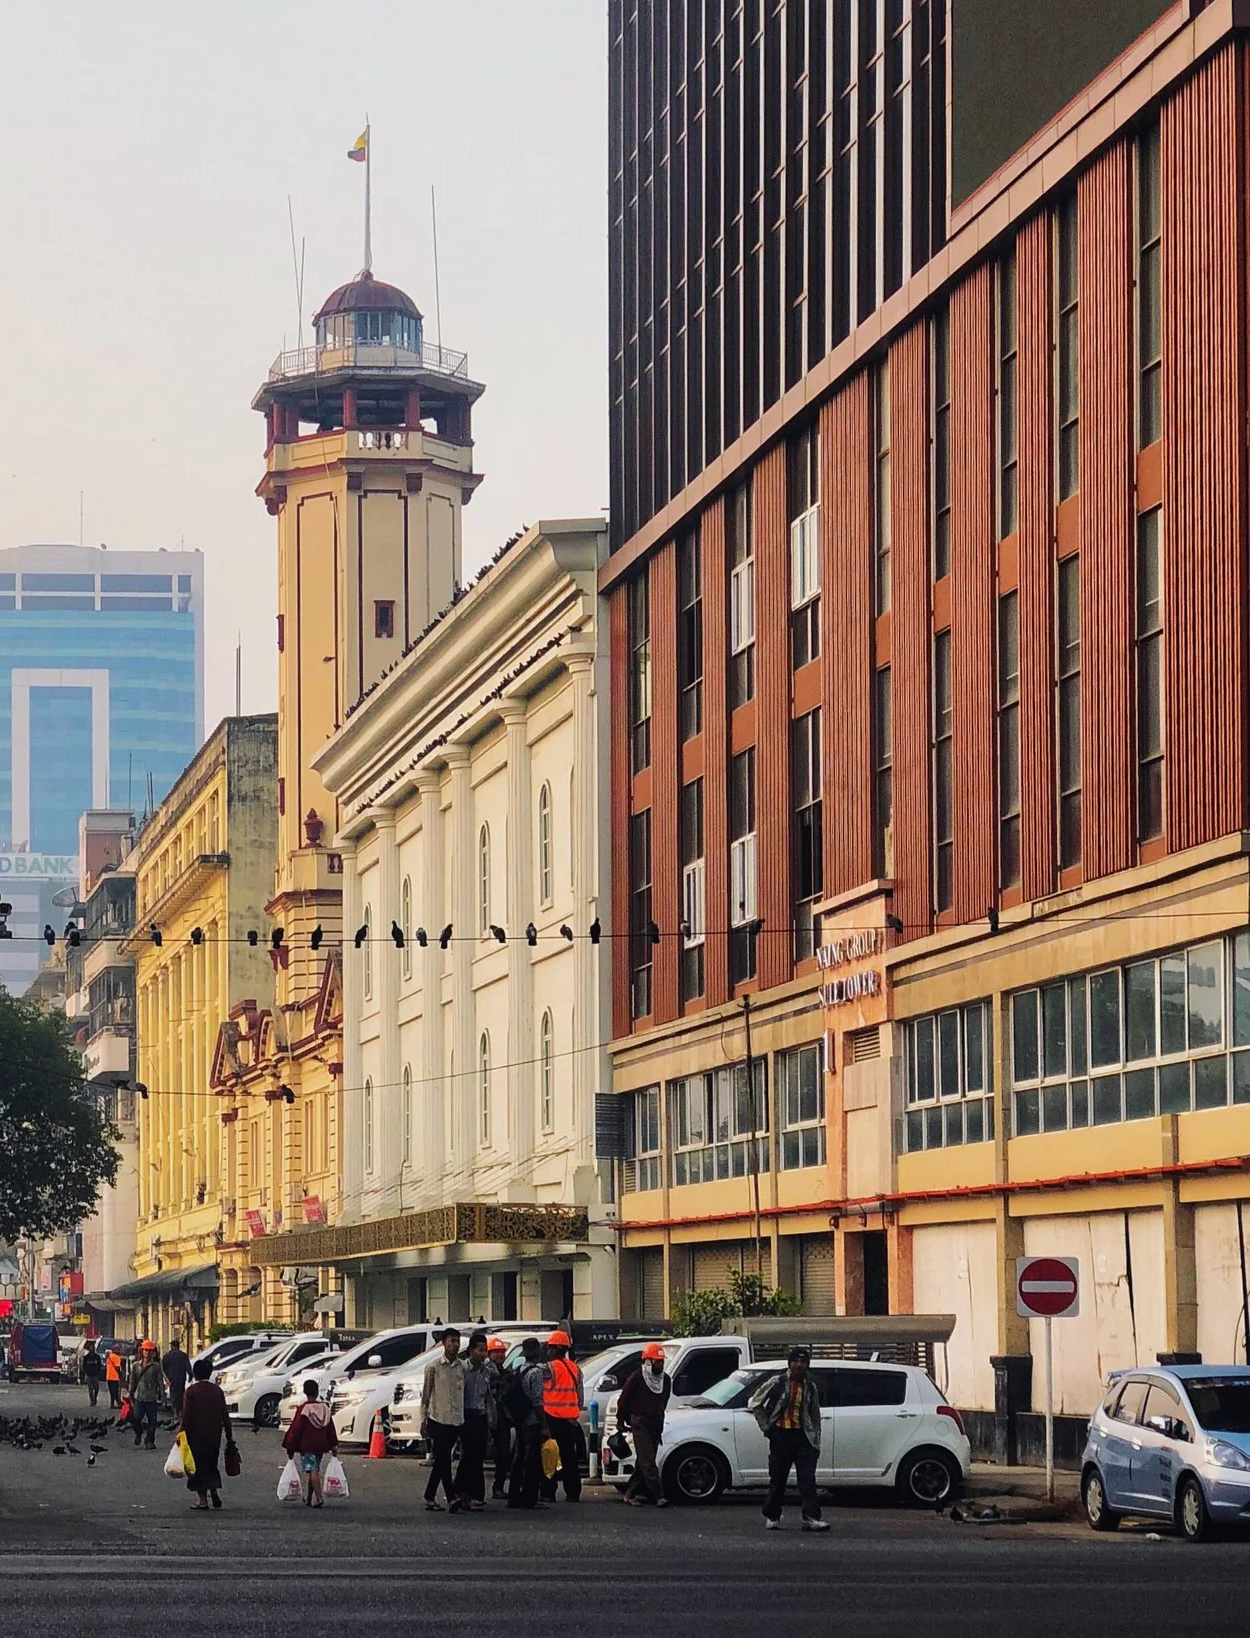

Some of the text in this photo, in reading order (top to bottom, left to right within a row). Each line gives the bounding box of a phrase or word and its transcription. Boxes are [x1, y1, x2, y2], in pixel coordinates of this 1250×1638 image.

[15, 857, 73, 874] BANK
[847, 929, 876, 960] GROUP
[818, 970, 875, 1008] SULE TOWER
